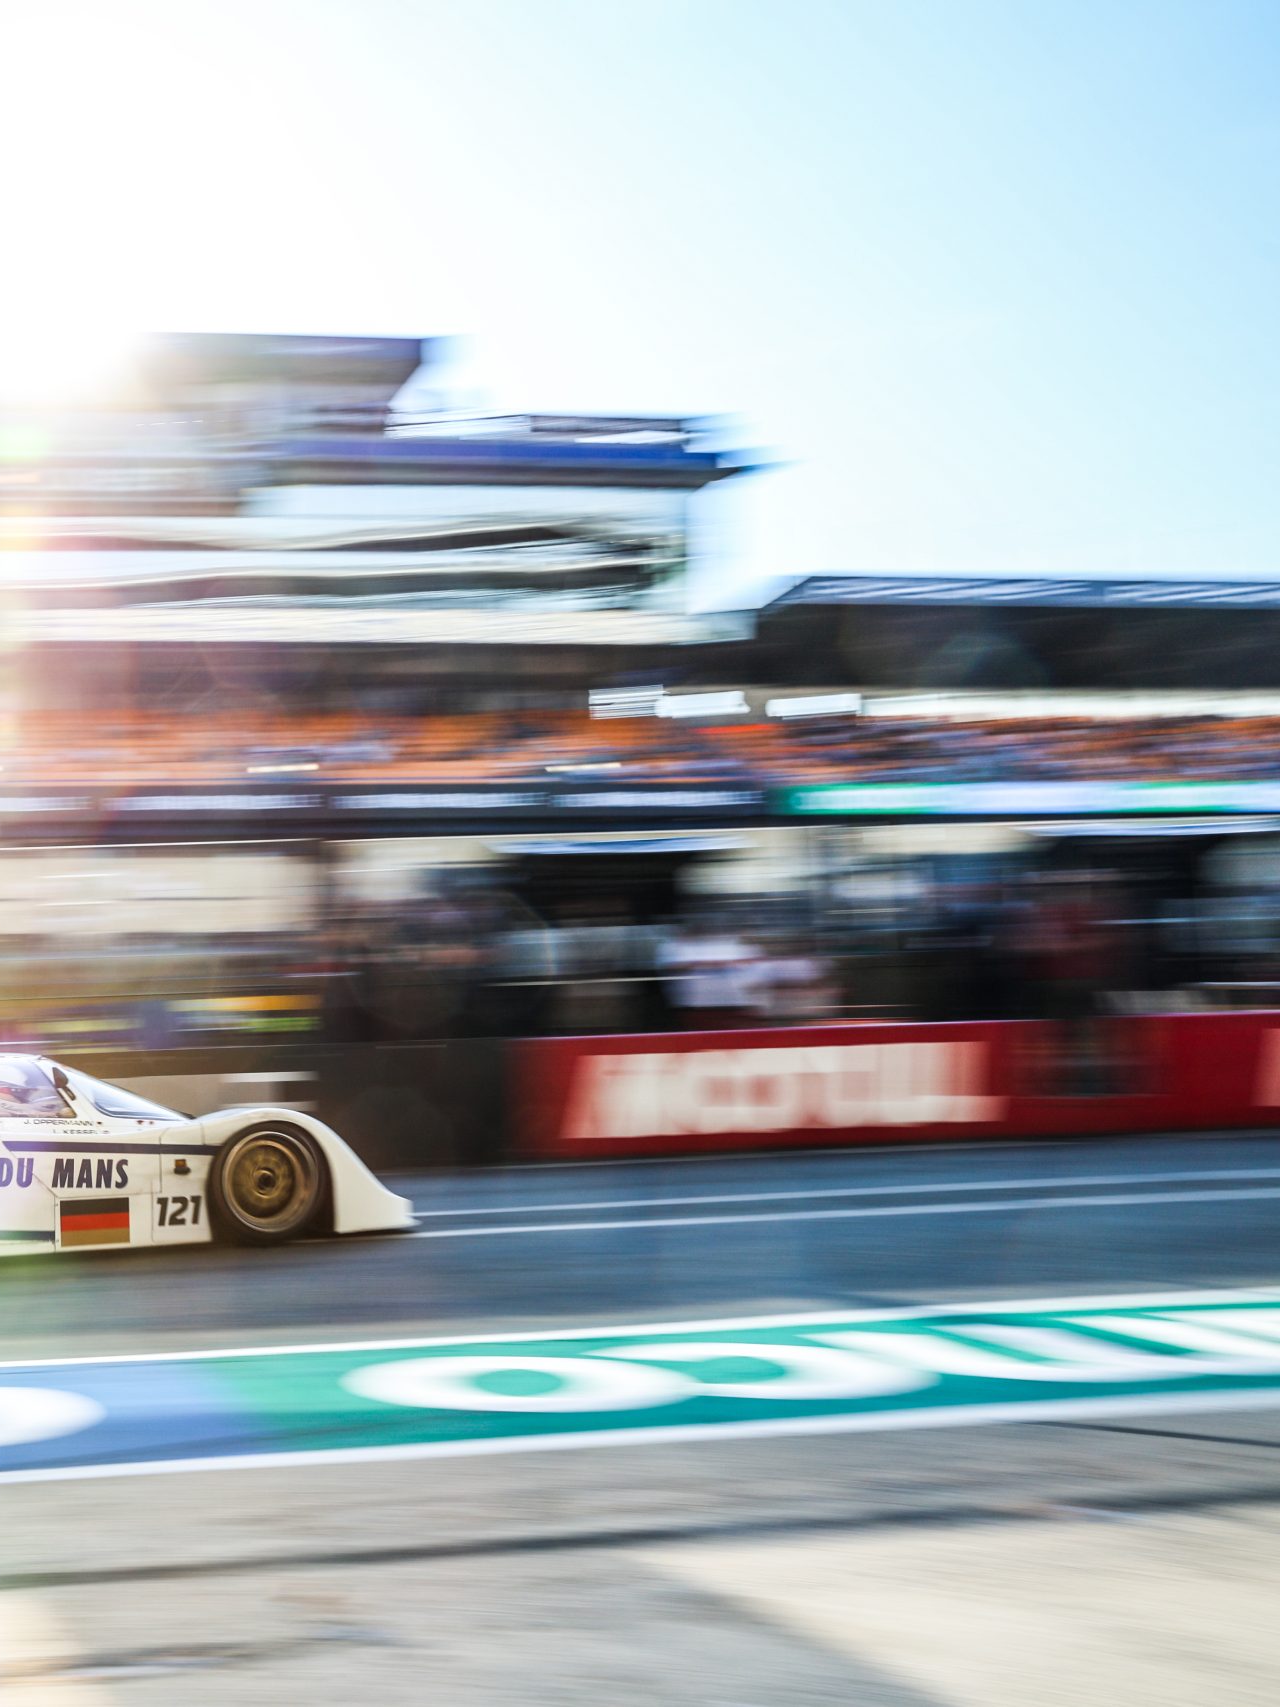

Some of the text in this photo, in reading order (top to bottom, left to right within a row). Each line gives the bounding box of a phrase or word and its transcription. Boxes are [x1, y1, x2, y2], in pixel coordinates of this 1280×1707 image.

[33, 1119, 94, 1127] OPPERMANN
[51, 1158, 129, 1189] MANS
[156, 1195, 202, 1227] 121
